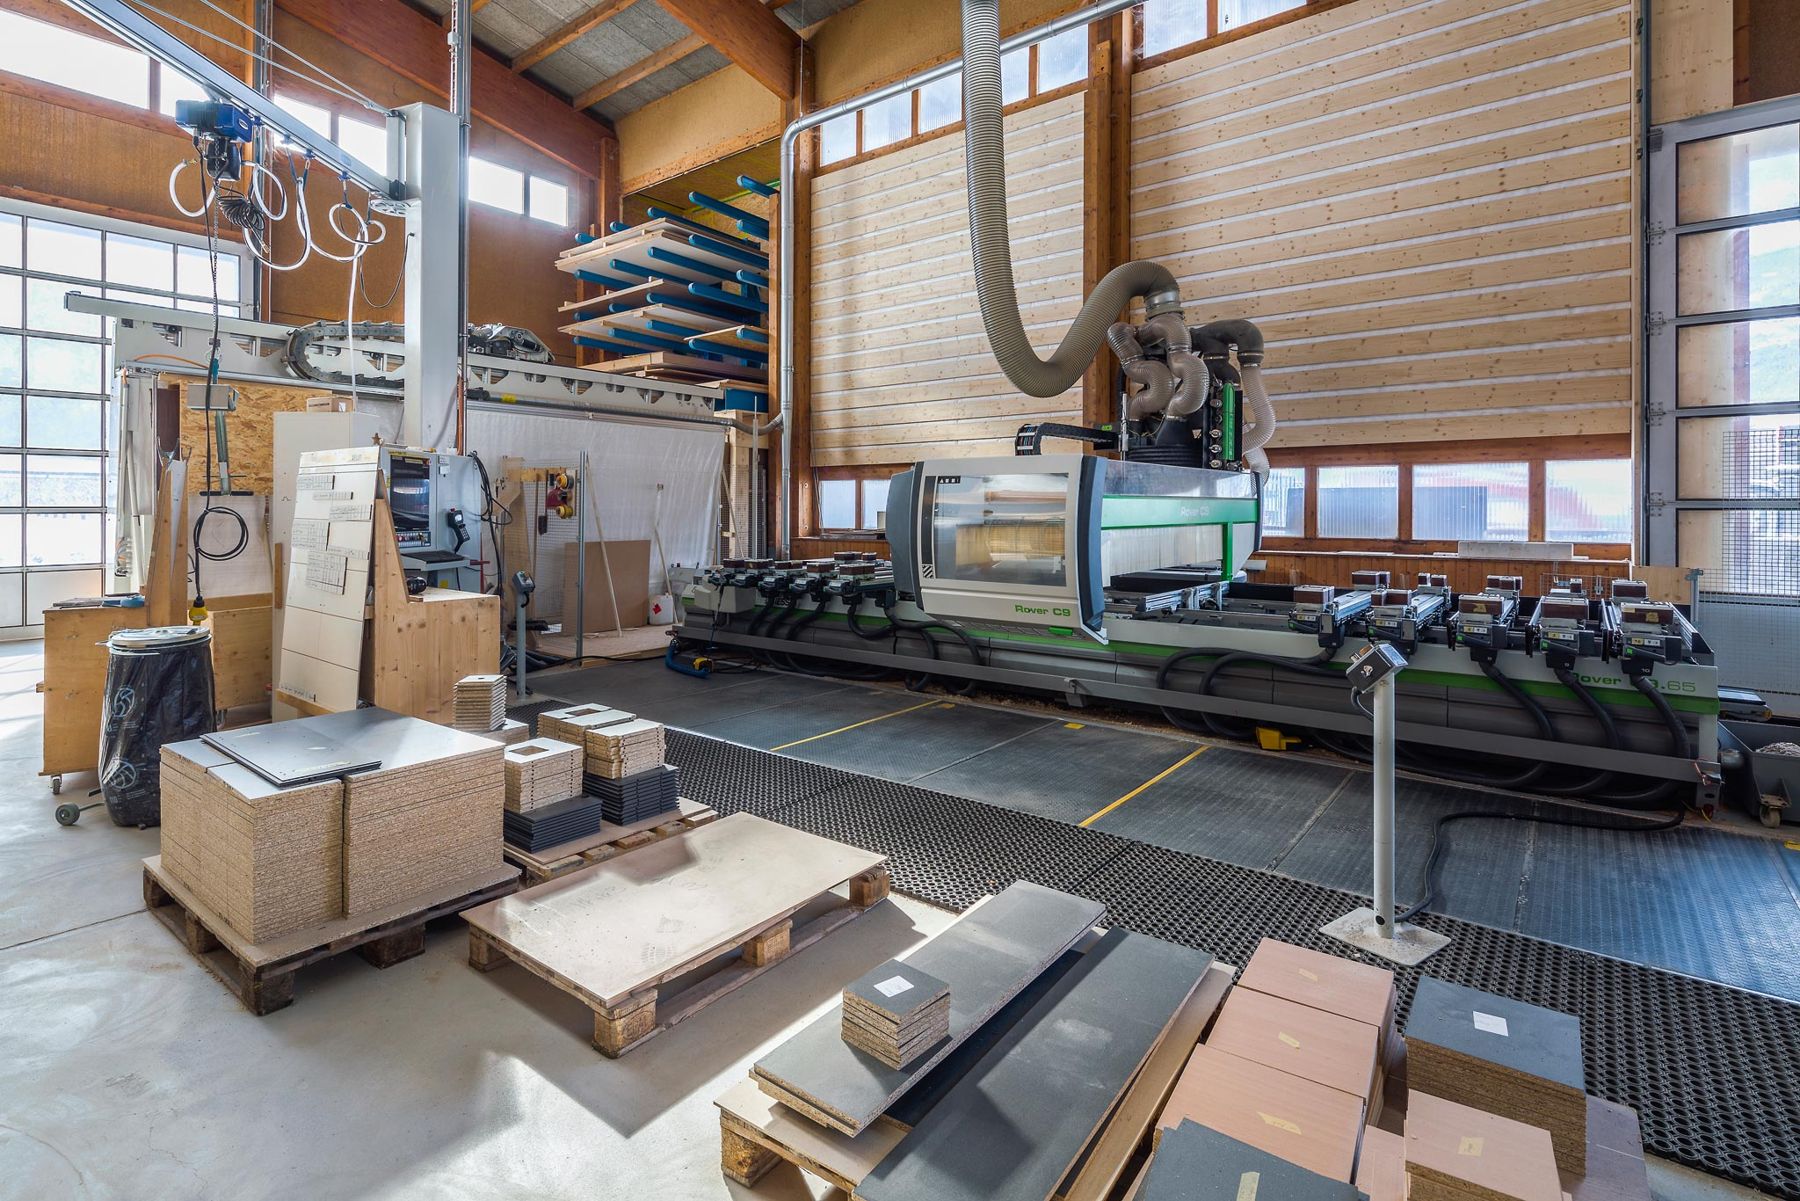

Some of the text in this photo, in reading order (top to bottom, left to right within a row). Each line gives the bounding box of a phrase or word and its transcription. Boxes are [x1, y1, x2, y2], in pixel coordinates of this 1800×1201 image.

[1014, 604, 1071, 617] Rover C9
[1633, 677, 1697, 692] 9.65
